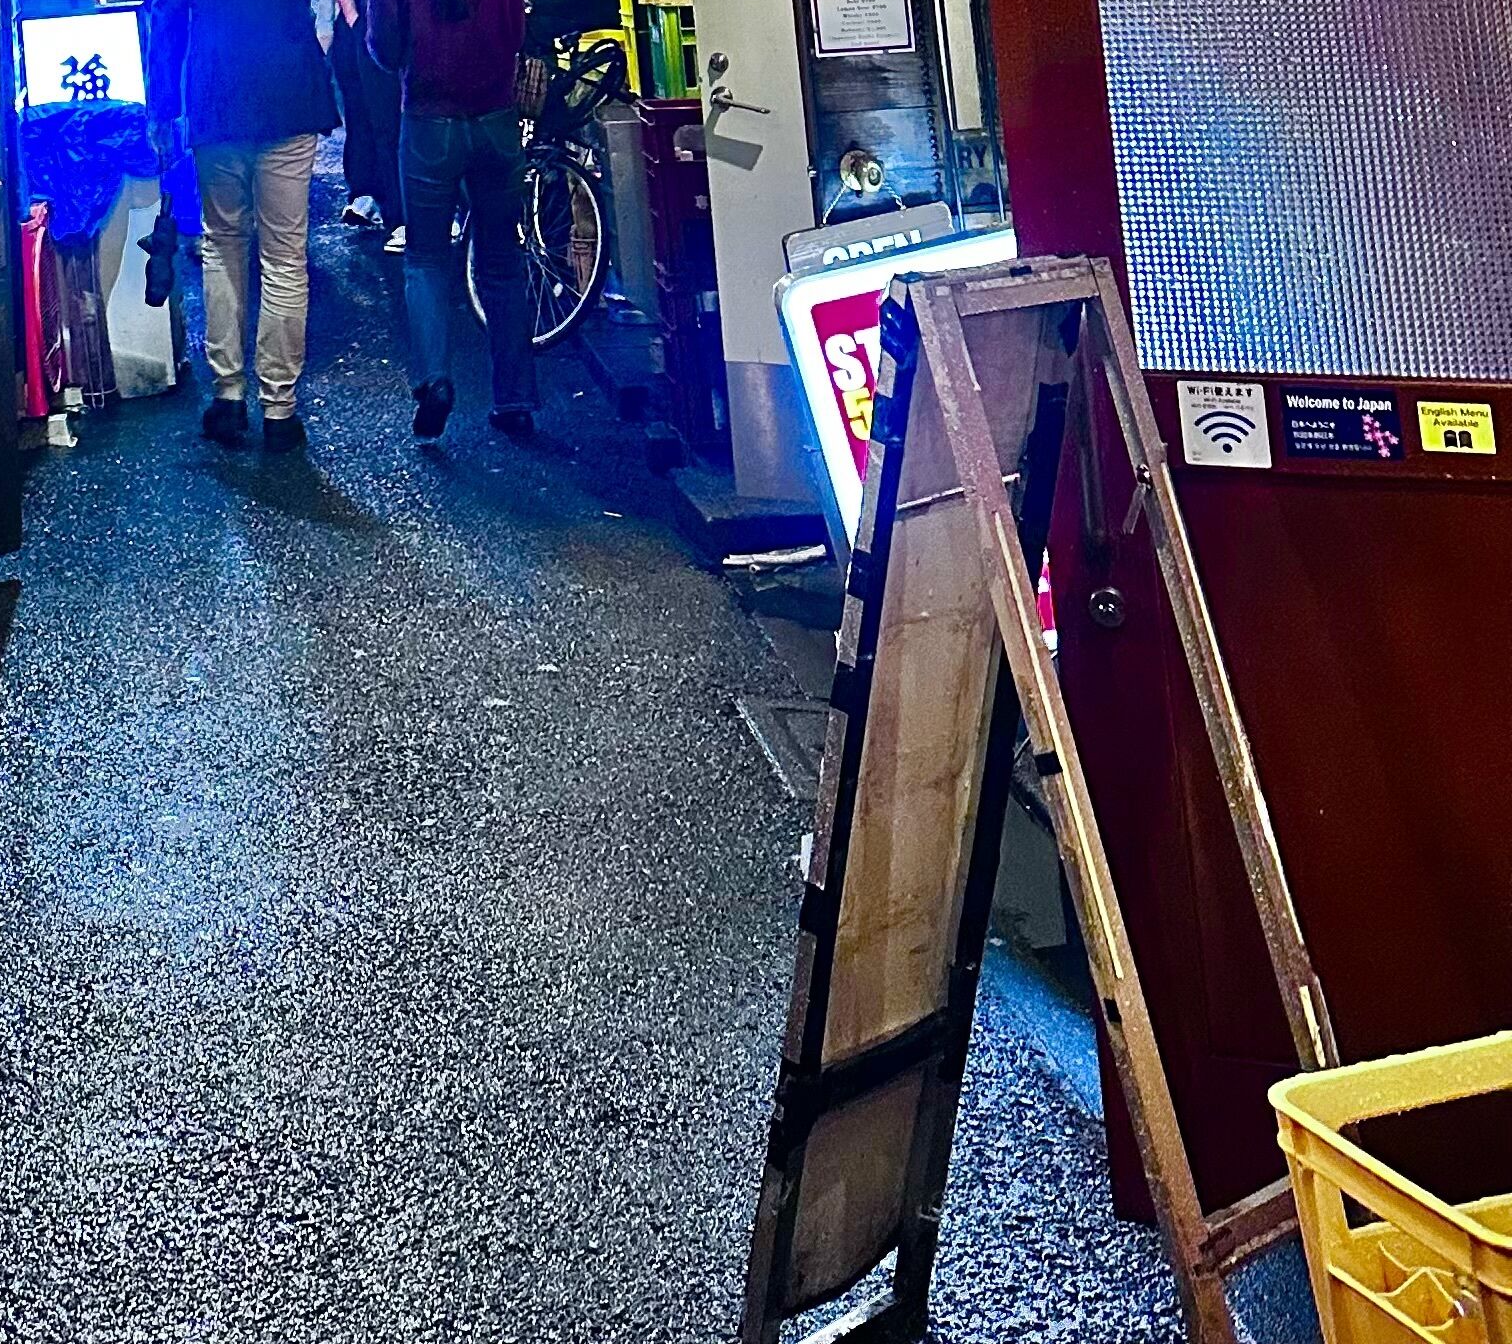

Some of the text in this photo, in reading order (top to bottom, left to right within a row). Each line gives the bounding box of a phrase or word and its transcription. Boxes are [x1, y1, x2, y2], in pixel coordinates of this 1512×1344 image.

[1286, 395, 1392, 412] Welcome to Japan
[1421, 406, 1489, 418] English Menu
[1432, 418, 1479, 429] Available
